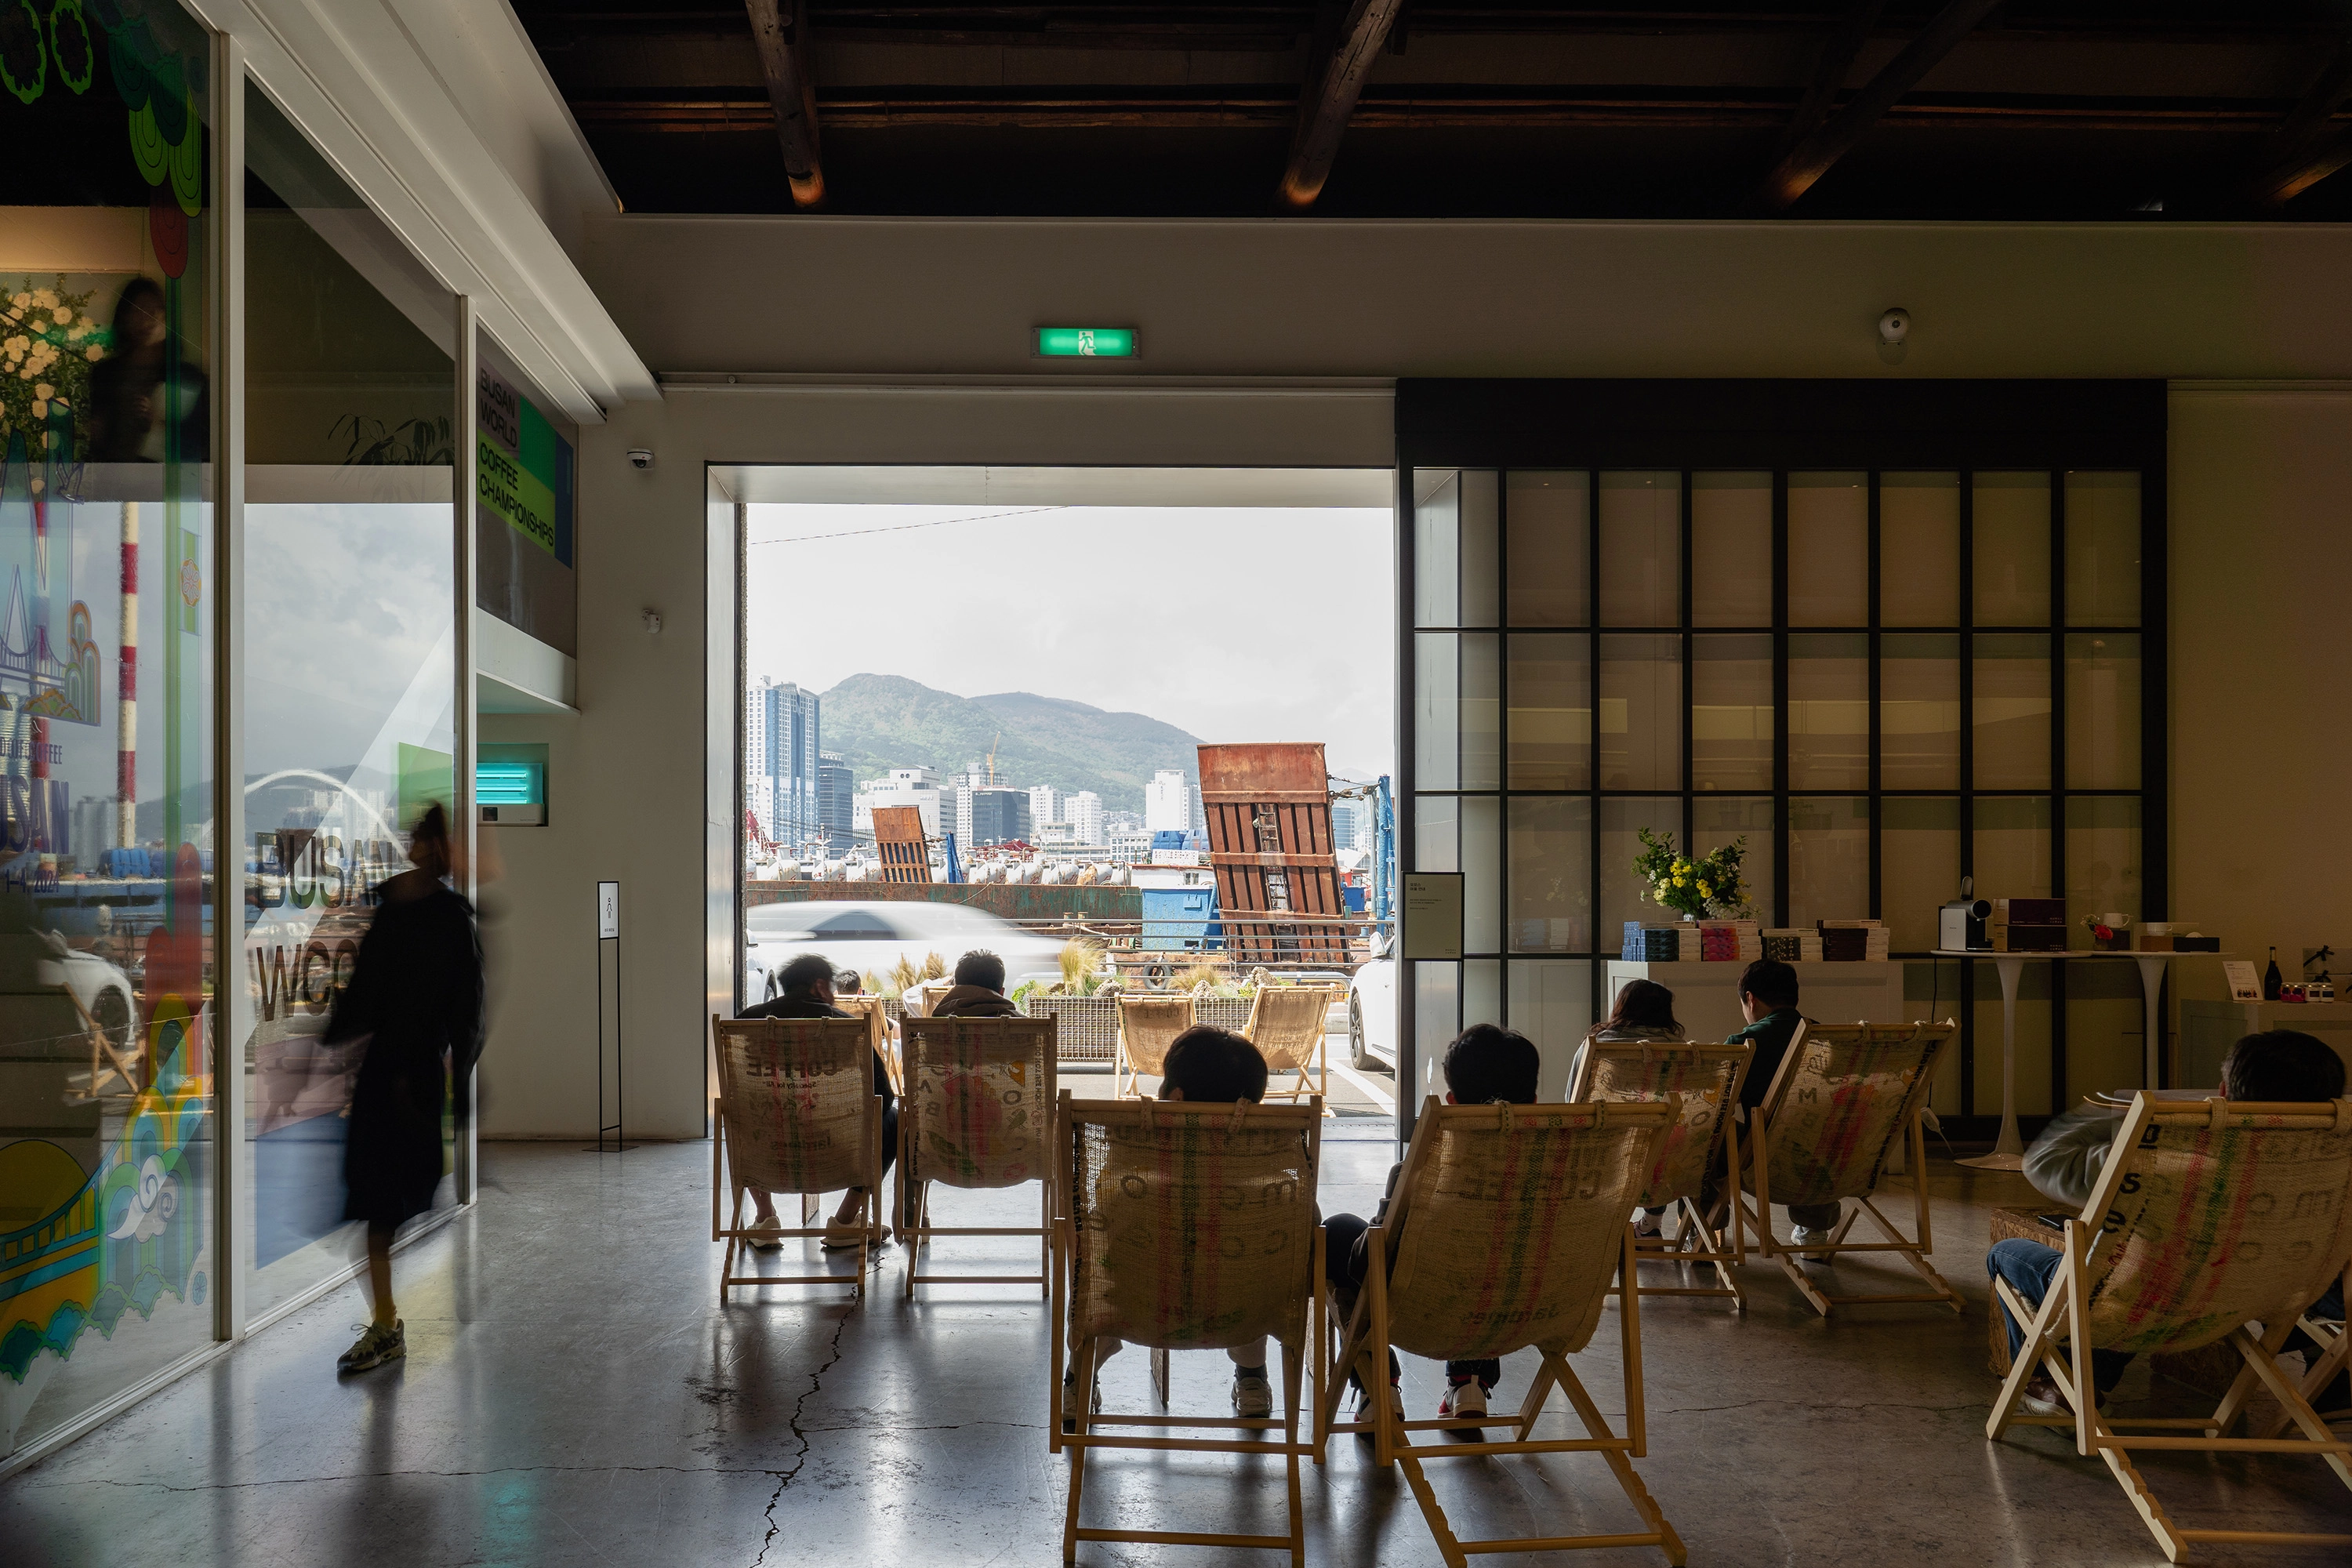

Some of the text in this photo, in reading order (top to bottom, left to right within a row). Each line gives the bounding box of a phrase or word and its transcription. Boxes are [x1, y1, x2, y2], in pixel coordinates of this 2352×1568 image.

[481, 368, 515, 418] BUSAN
[481, 398, 517, 448] WORLD
[480, 442, 518, 491] COFFEE
[480, 473, 554, 546] CHAMPIONSHIPS
[255, 831, 392, 909] BUSAN
